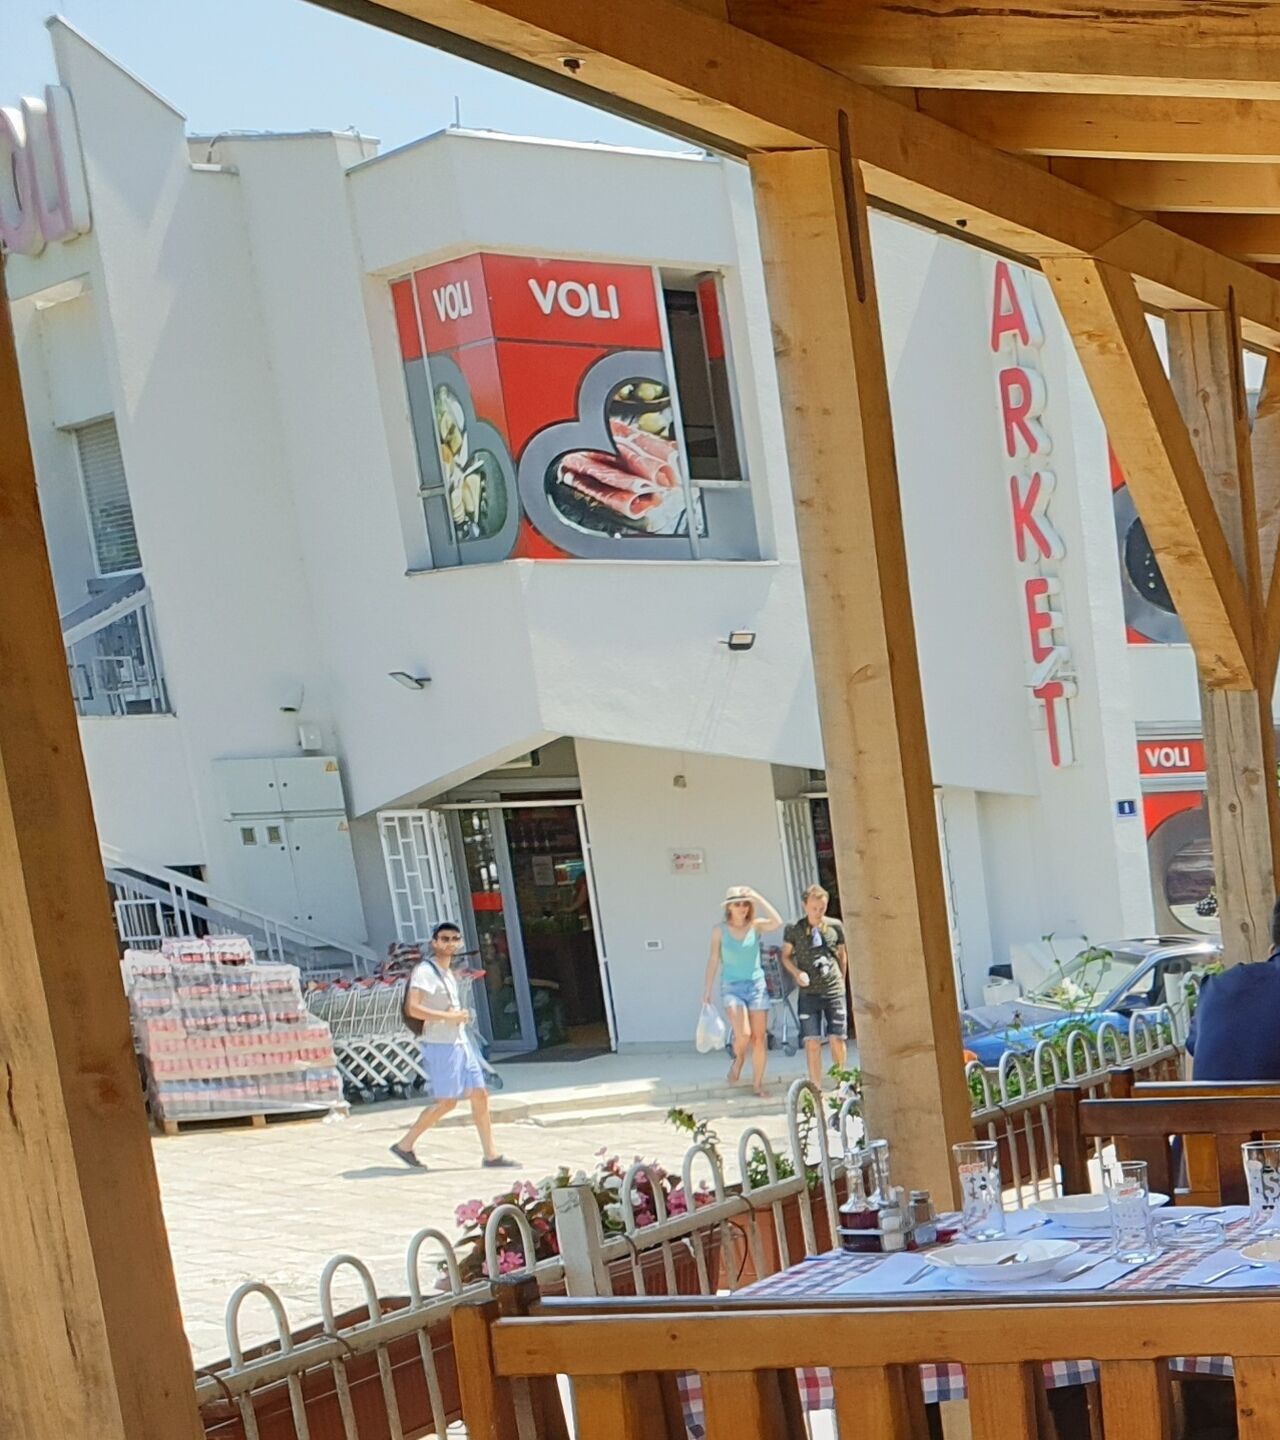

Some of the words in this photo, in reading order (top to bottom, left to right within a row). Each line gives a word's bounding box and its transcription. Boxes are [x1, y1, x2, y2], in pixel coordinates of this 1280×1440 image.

[432, 279, 473, 322] VOLI
[528, 278, 620, 320] VOLI
[1144, 746, 1191, 768] VOLI
